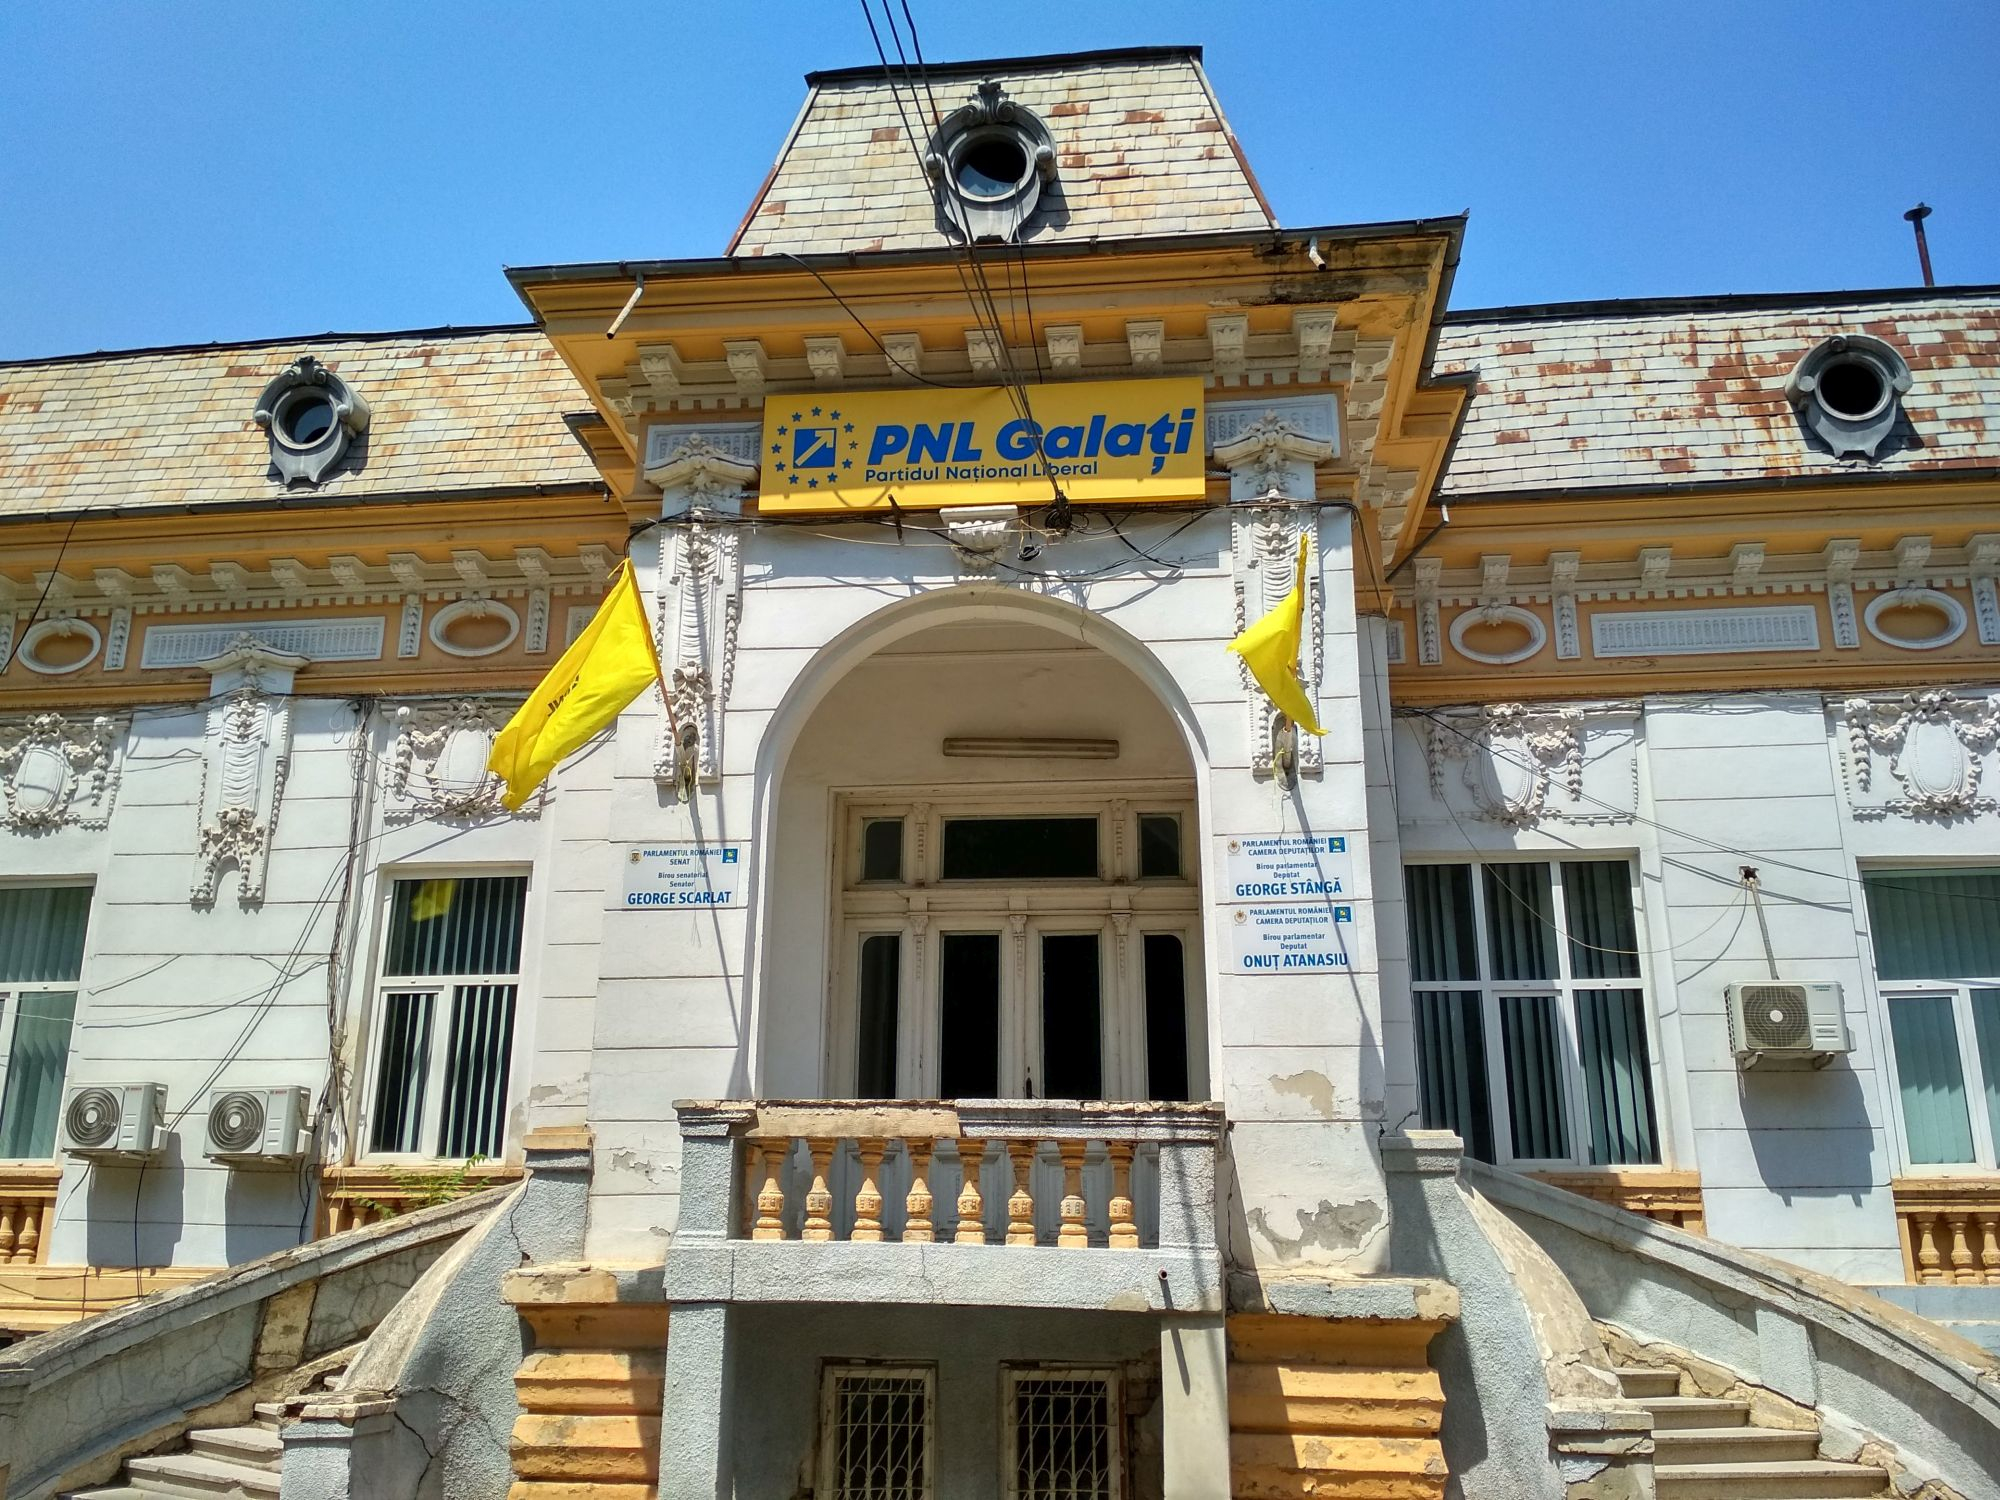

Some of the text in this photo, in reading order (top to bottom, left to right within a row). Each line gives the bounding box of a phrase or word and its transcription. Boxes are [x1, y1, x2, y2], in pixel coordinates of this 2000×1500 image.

[867, 408, 1196, 475] PNL Galați
[865, 461, 1097, 482] Partidul Național Liberal
[1242, 839, 1291, 848] PARLAMENTUL
[643, 849, 688, 857] PARLAMENTUL
[1248, 848, 1277, 856] CAMERA
[669, 858, 690, 866] SENAT
[1256, 861, 1318, 870] Birou parlamentar
[677, 871, 708, 879] senatorial
[1273, 871, 1300, 879] Deputat
[669, 880, 695, 888] Senator
[1236, 877, 1342, 897] GEORGE STÂNGĂ
[628, 891, 732, 905] GEORGE SCARLAT
[1249, 908, 1296, 916] PARLAMENTUL
[1263, 932, 1325, 942] Birou parlamentar
[1280, 942, 1308, 951] Deputat
[1243, 952, 1348, 971] ONUȚ ATANASIU
